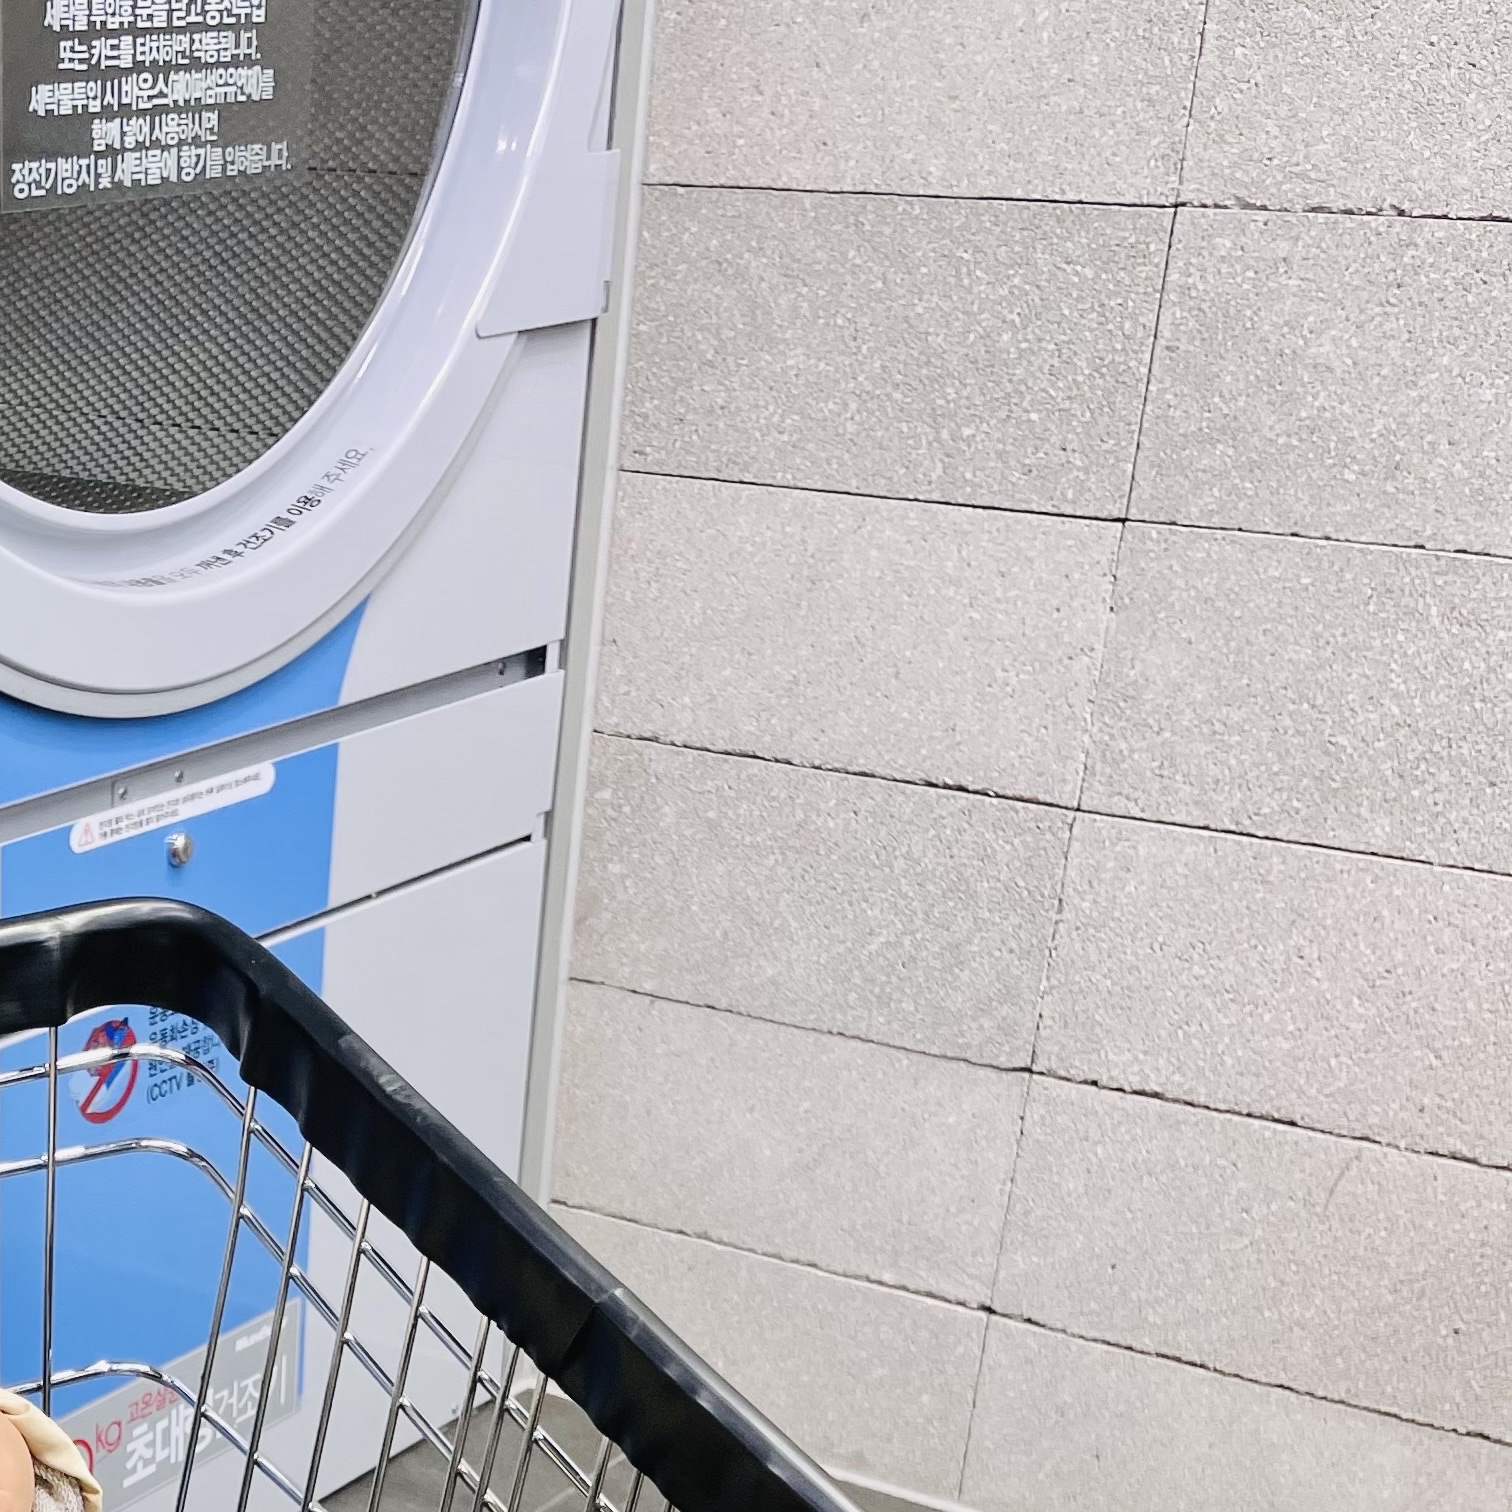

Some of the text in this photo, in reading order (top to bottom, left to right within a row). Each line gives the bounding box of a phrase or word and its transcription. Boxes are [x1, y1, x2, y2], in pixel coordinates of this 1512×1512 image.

[57, 28, 262, 71] 또는 카드를 터치하면 작동됩니다.
[103, 78, 119, 112] 시
[91, 109, 220, 152] 함께 넣어 사용하시면
[11, 140, 292, 199] 정전기방지 및 세탁물에 향기를 입혀줍니다.
